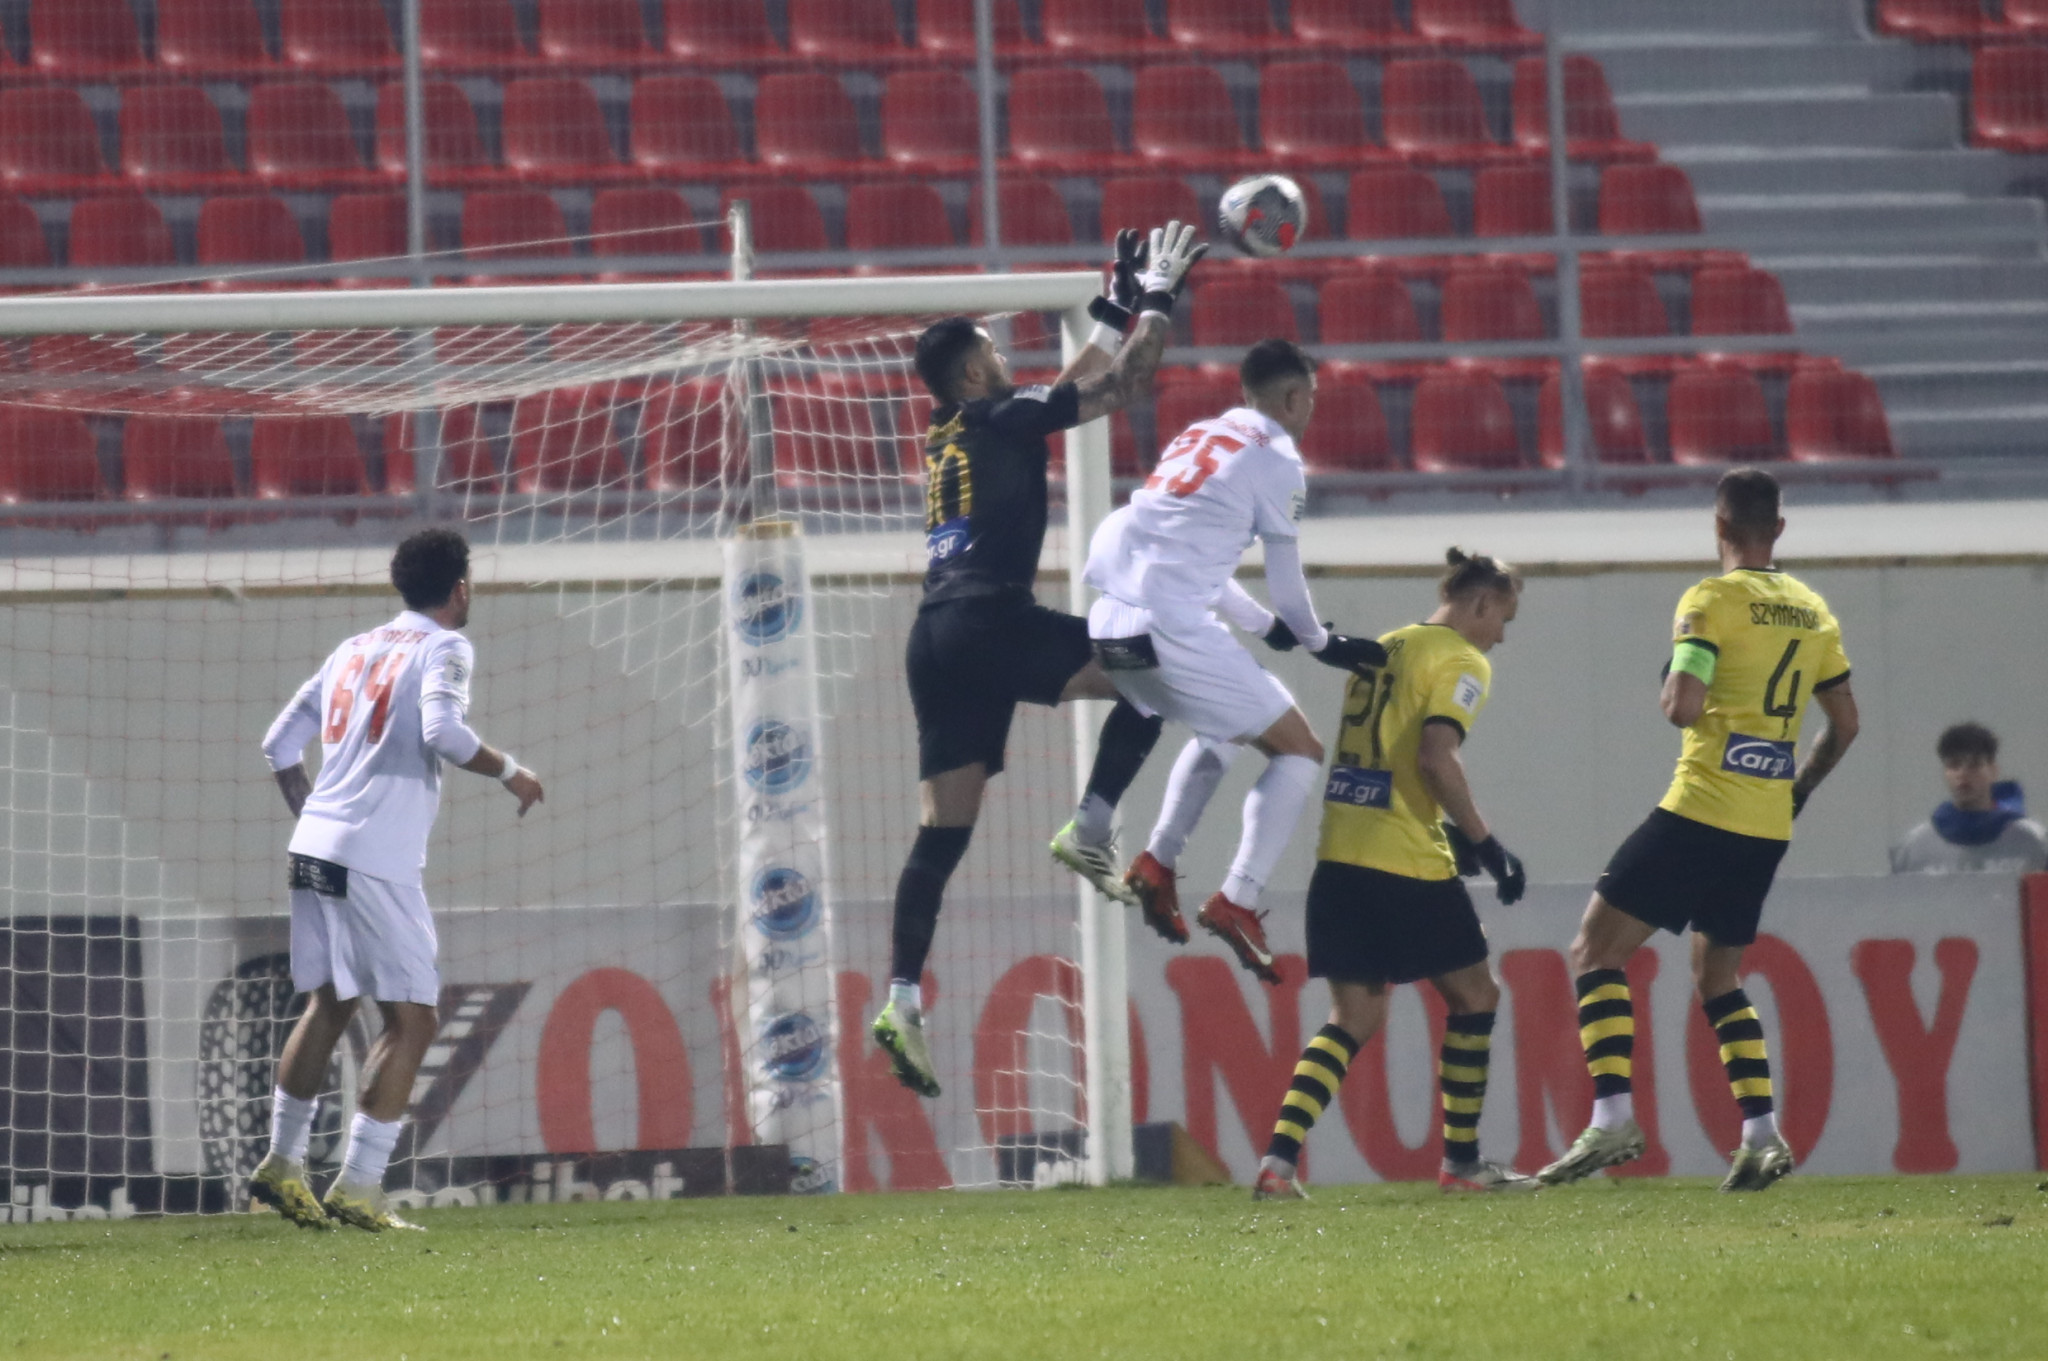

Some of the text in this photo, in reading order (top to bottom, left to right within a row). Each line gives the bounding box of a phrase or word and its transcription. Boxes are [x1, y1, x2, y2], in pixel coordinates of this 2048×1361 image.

[1143, 427, 1246, 499] 25
[322, 652, 406, 745] 64
[1763, 638, 1801, 739] 4
